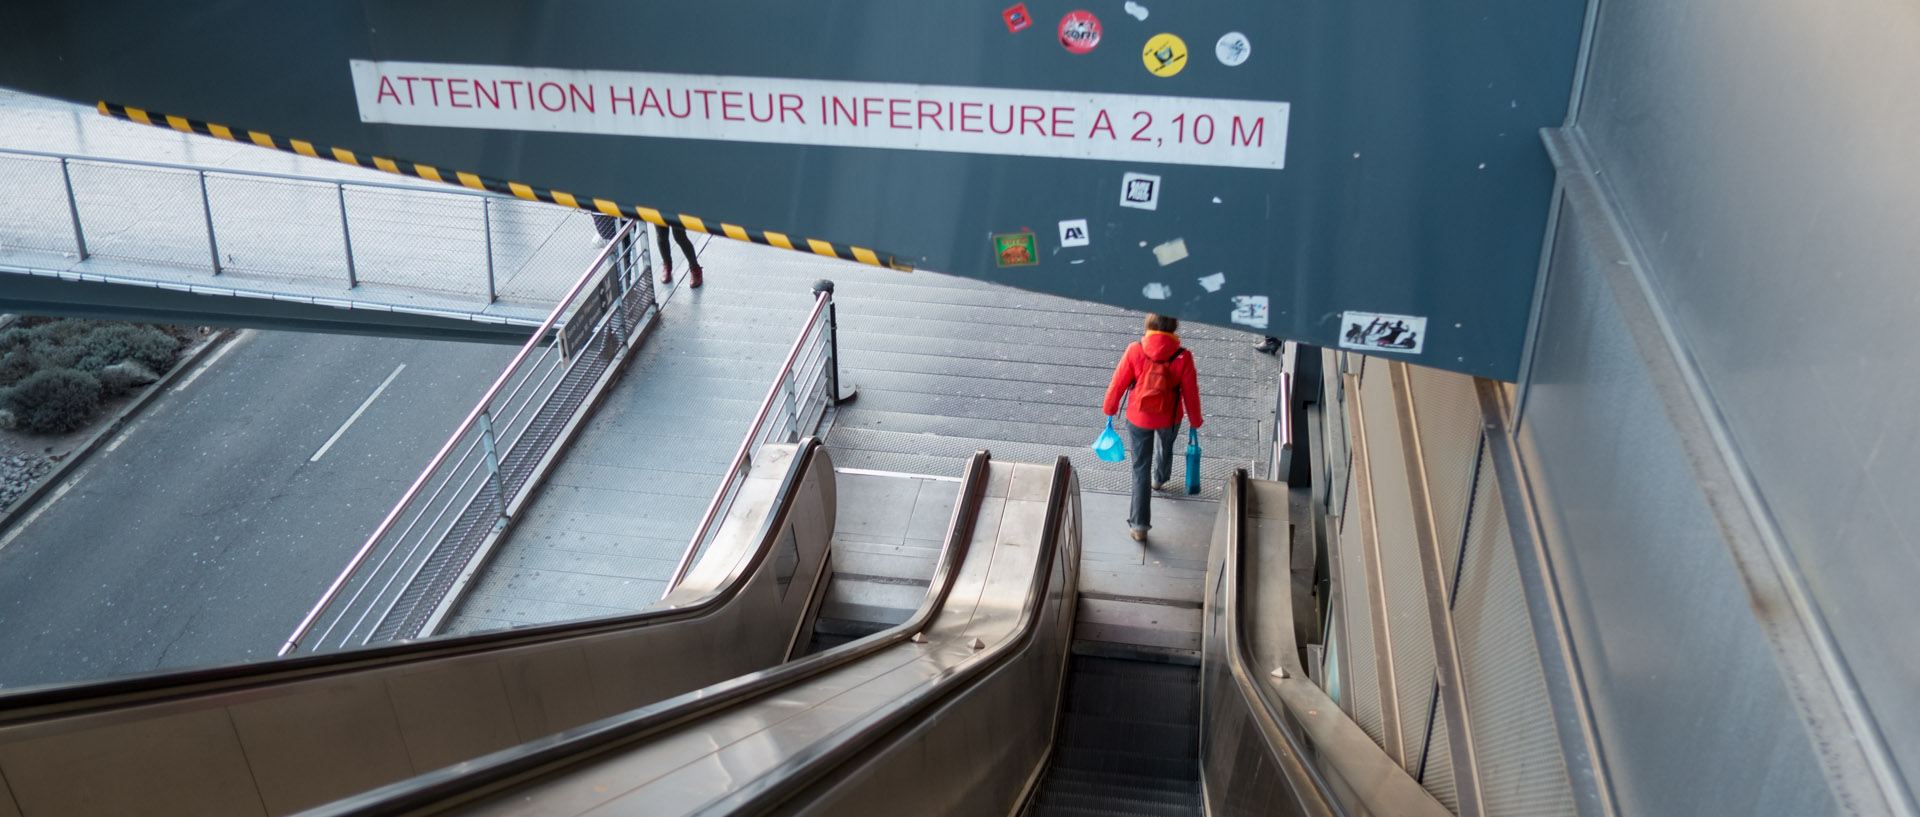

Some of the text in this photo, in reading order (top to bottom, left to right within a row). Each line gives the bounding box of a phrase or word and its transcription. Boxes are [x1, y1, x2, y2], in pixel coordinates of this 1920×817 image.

[377, 76, 1265, 148] ATTENTION HAUTEUR INFERIEURE A 2,10 M
